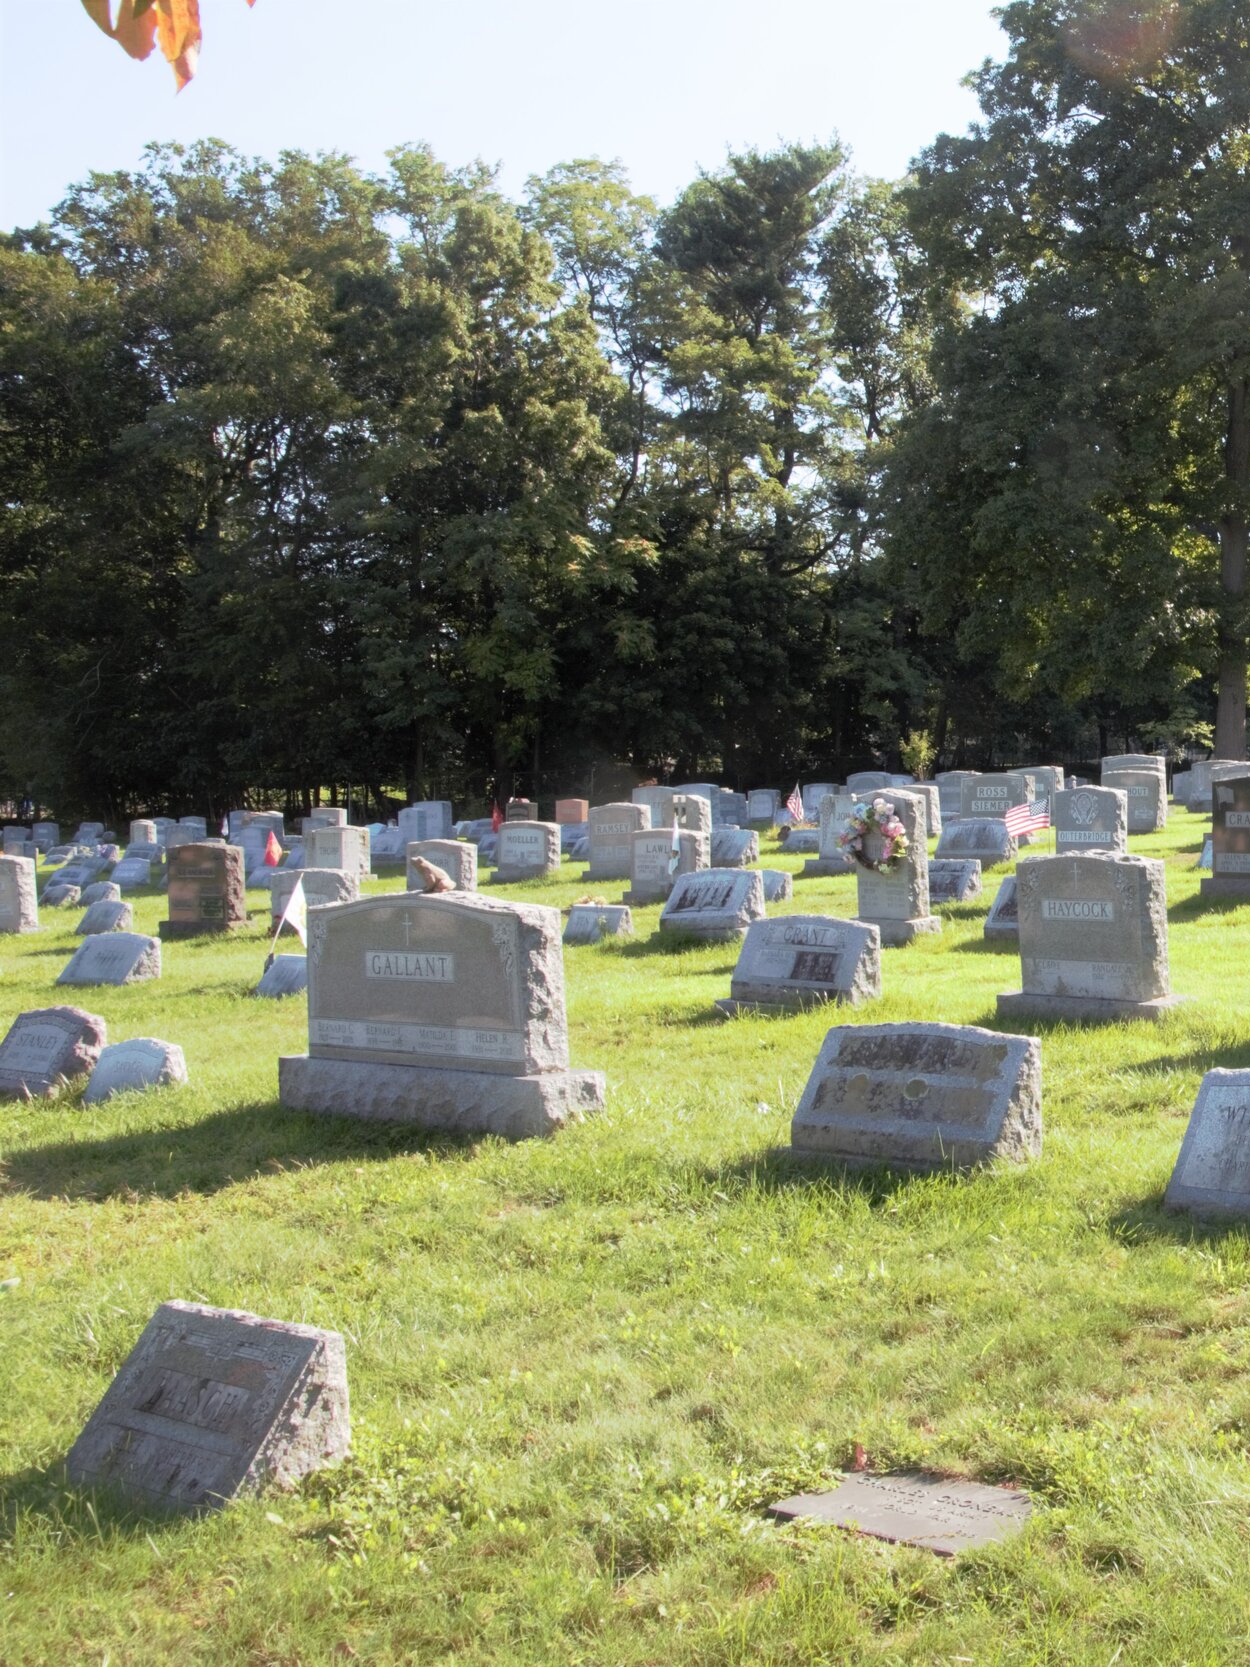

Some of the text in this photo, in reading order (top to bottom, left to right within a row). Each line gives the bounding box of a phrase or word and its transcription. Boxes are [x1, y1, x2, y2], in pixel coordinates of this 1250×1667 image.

[978, 787, 1007, 797] ROSS
[973, 801, 1010, 810] SIEMER
[597, 823, 629, 833] RAMSEY
[507, 836, 539, 844] MOELLER
[1060, 832, 1110, 841] OUTERBRIDGE
[1048, 902, 1108, 918] HAYCOCK
[783, 926, 830, 944] GRANT
[371, 955, 448, 977] GALLANT
[15, 1033, 59, 1050] STANLEY
[475, 1032, 498, 1043] HELEN
